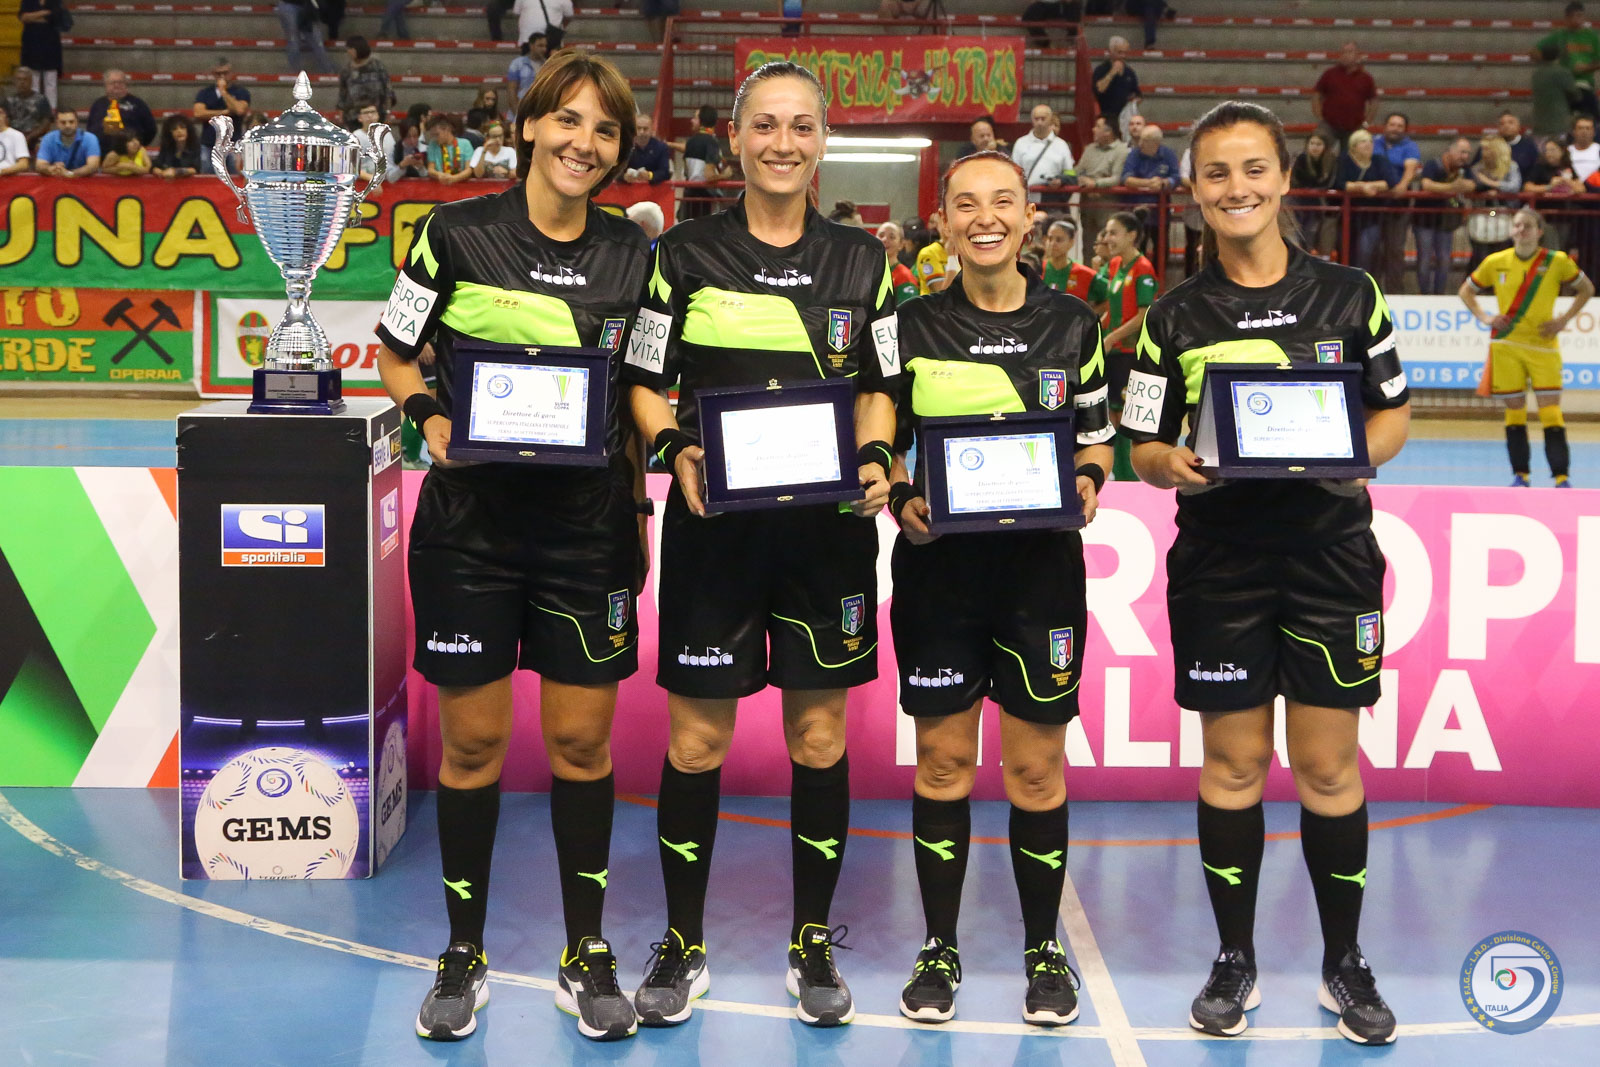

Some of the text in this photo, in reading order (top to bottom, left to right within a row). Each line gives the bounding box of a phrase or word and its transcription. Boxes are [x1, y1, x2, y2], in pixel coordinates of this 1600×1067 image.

[530, 263, 586, 286] diadora
[754, 268, 812, 287] diadora
[394, 278, 429, 313] EURO
[387, 300, 415, 337] VITA
[633, 315, 666, 340] EURO
[1237, 310, 1297, 329] diadora
[629, 338, 661, 365] VITA
[969, 337, 1028, 355] diadora
[109, 369, 182, 380] OPERAIA
[1124, 402, 1156, 425] VITA
[241, 551, 306, 564] sportitalia
[427, 631, 482, 653] diadora
[678, 645, 734, 666] diadora
[909, 667, 964, 687] diadora
[1189, 661, 1248, 682] diadora
[222, 816, 331, 842] GEMS
